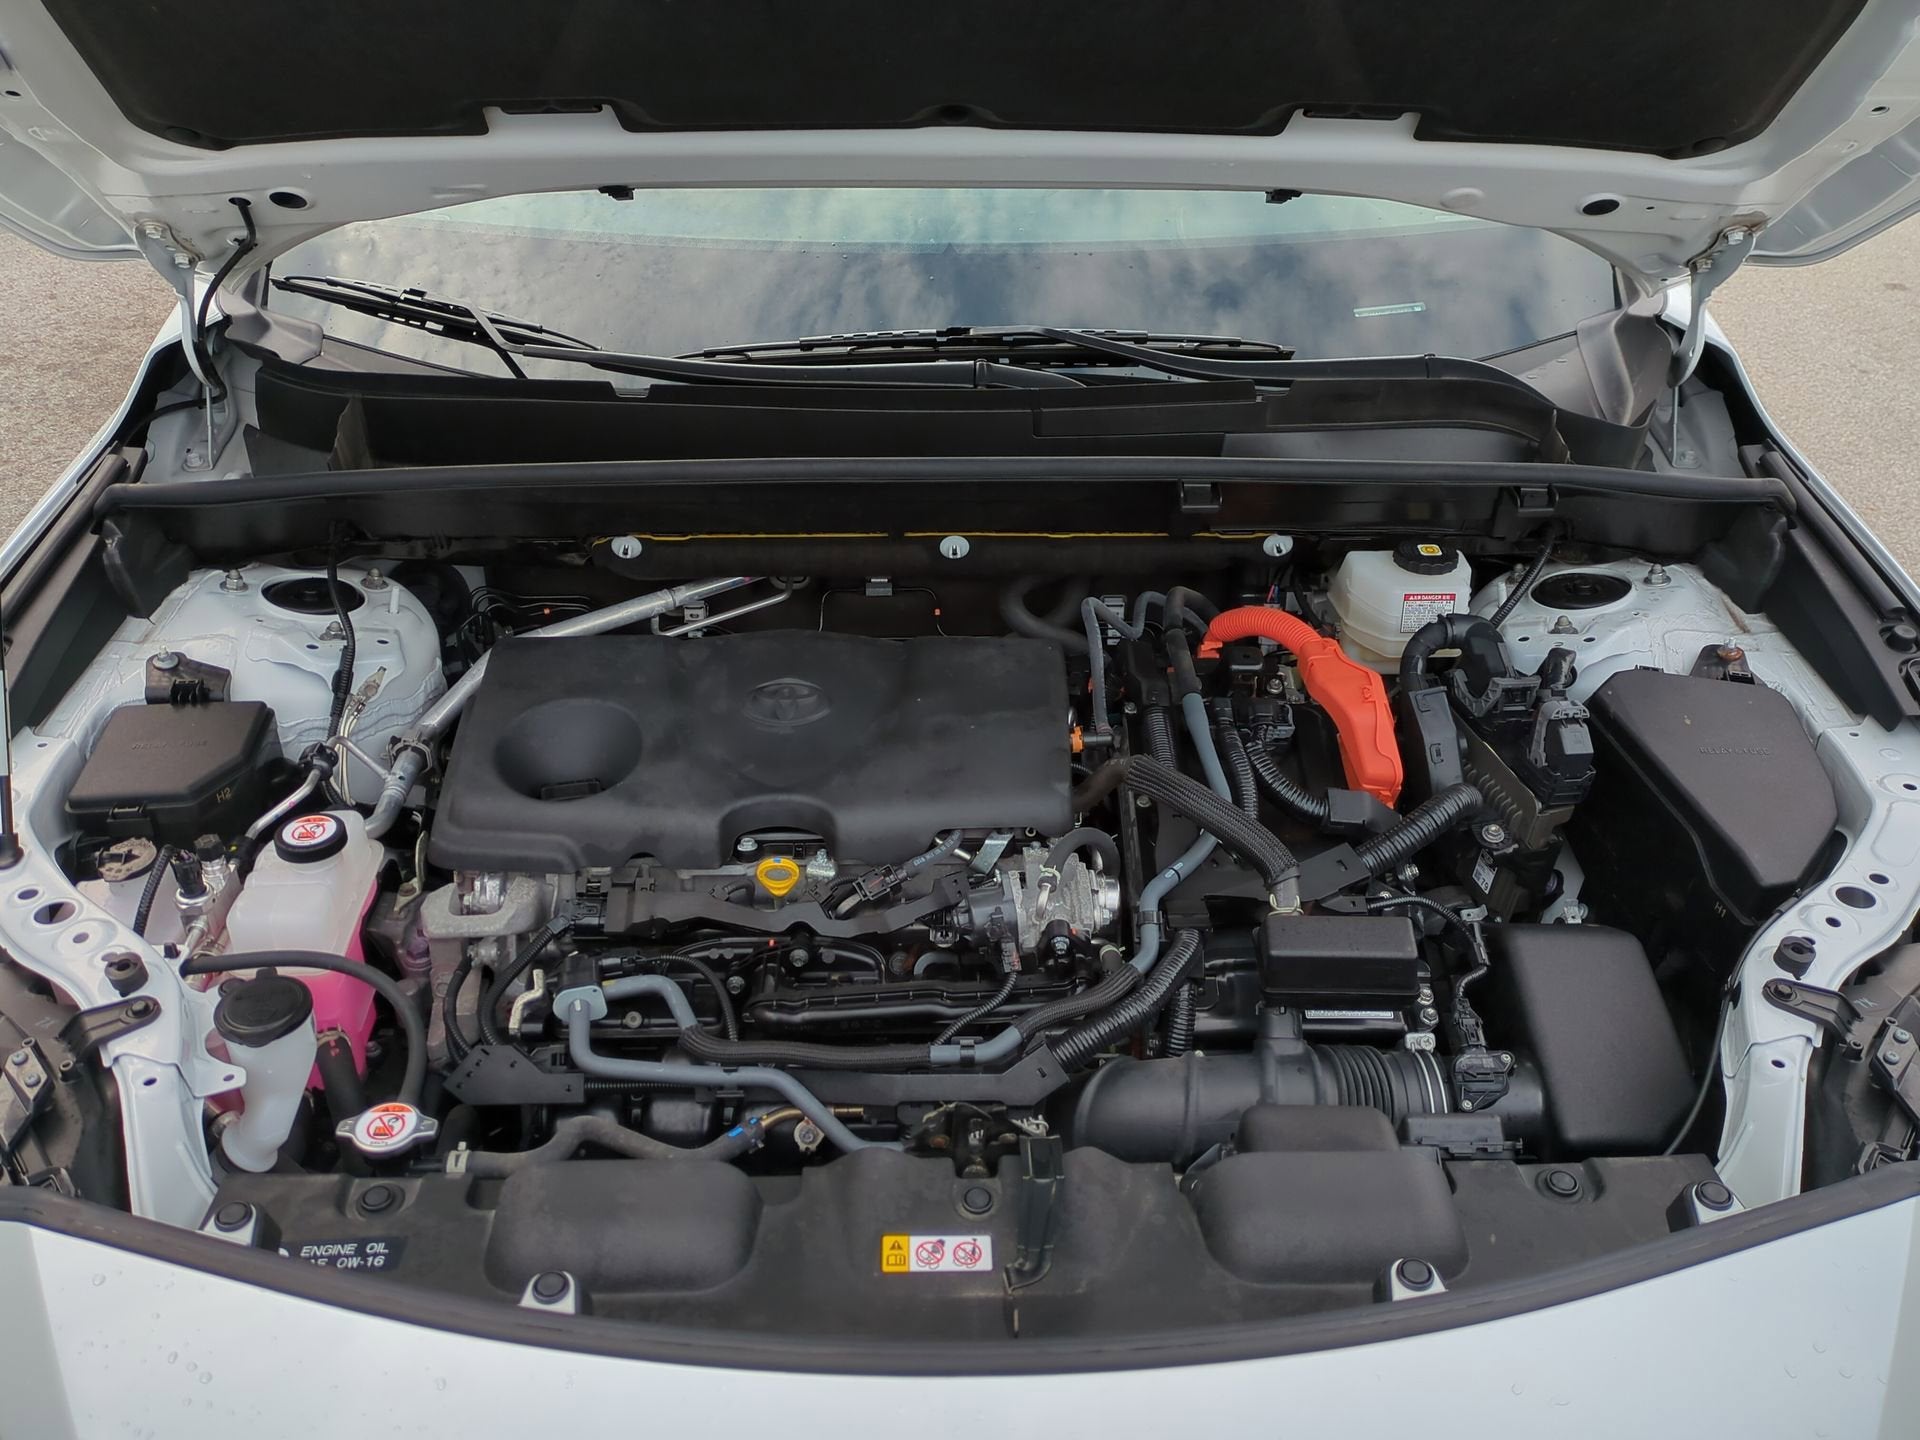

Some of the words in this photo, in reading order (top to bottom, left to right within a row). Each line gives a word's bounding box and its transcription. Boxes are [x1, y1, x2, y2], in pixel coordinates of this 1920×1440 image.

[216, 787, 231, 803] H2
[1714, 901, 1726, 918] H1
[300, 1243, 358, 1257] ENGINE
[366, 1242, 389, 1254] OIL
[336, 1255, 385, 1269] 0W-16
